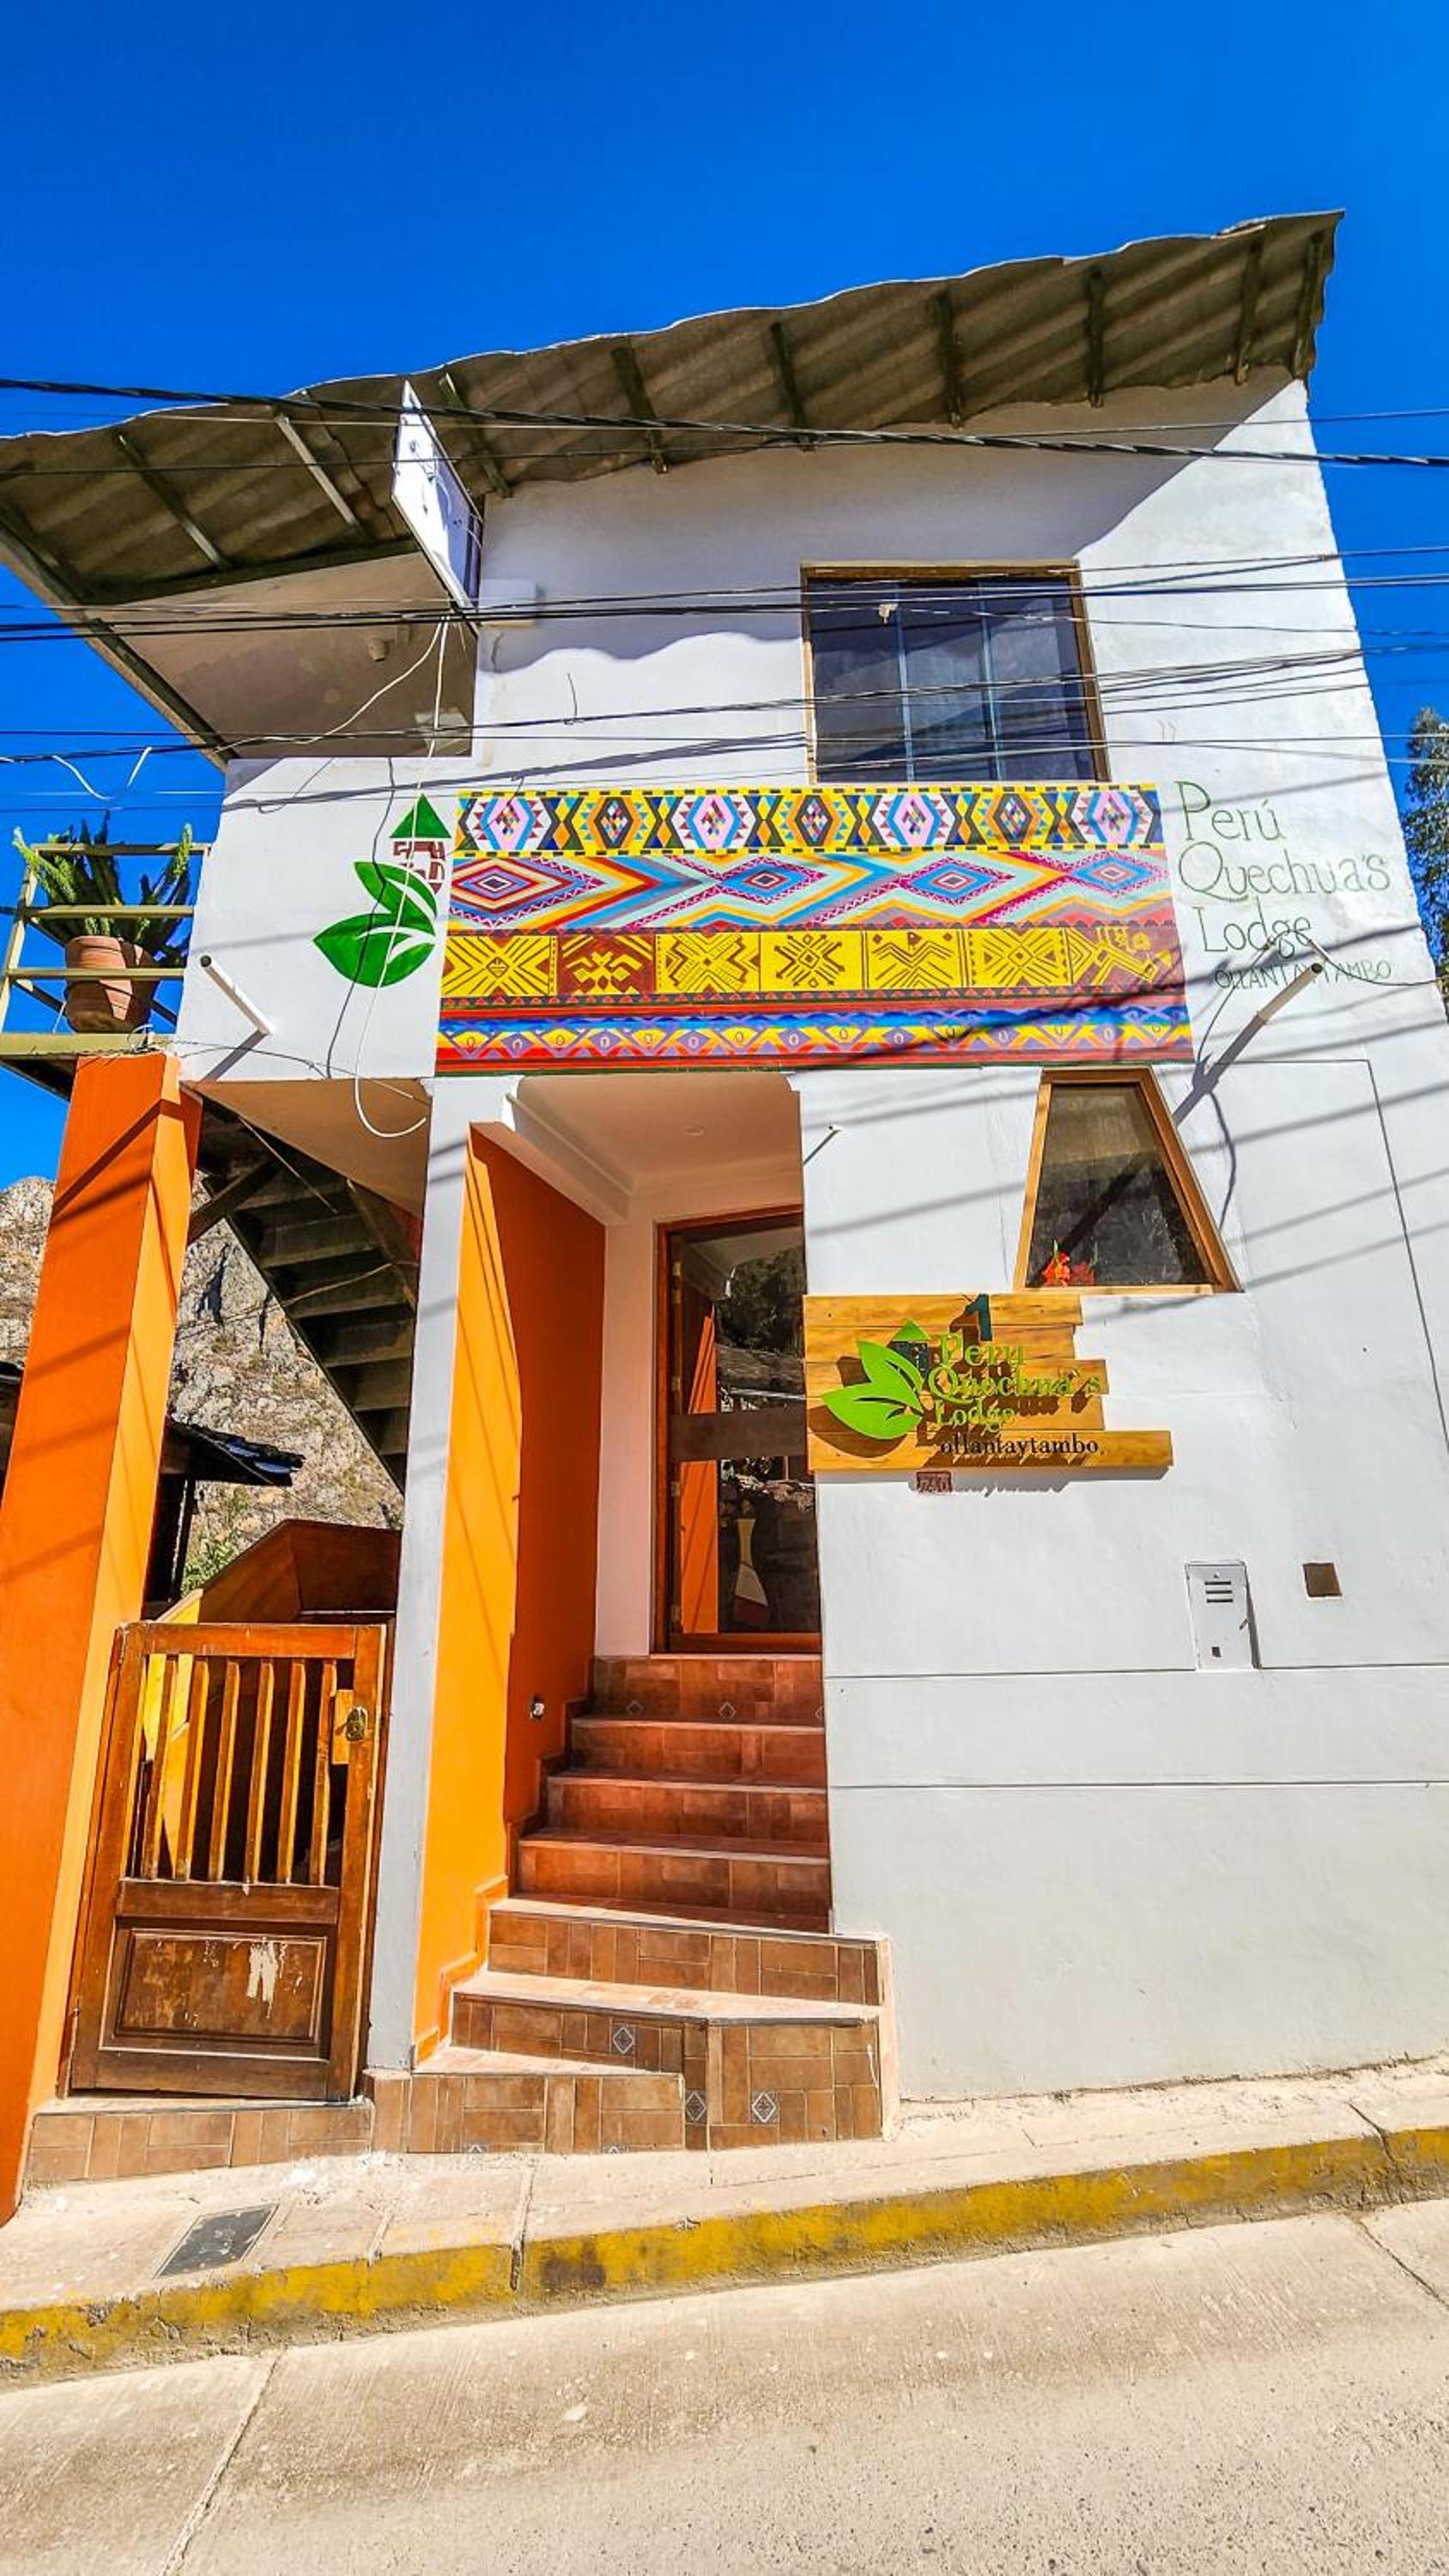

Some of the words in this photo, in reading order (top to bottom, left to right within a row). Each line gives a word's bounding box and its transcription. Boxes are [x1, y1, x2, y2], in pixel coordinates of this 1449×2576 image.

[1174, 781, 1286, 841] Perú
[1191, 896, 1312, 959] Lodge
[934, 1397, 1017, 1432] Lodge
[939, 1431, 1100, 1458] ollantaytambo
